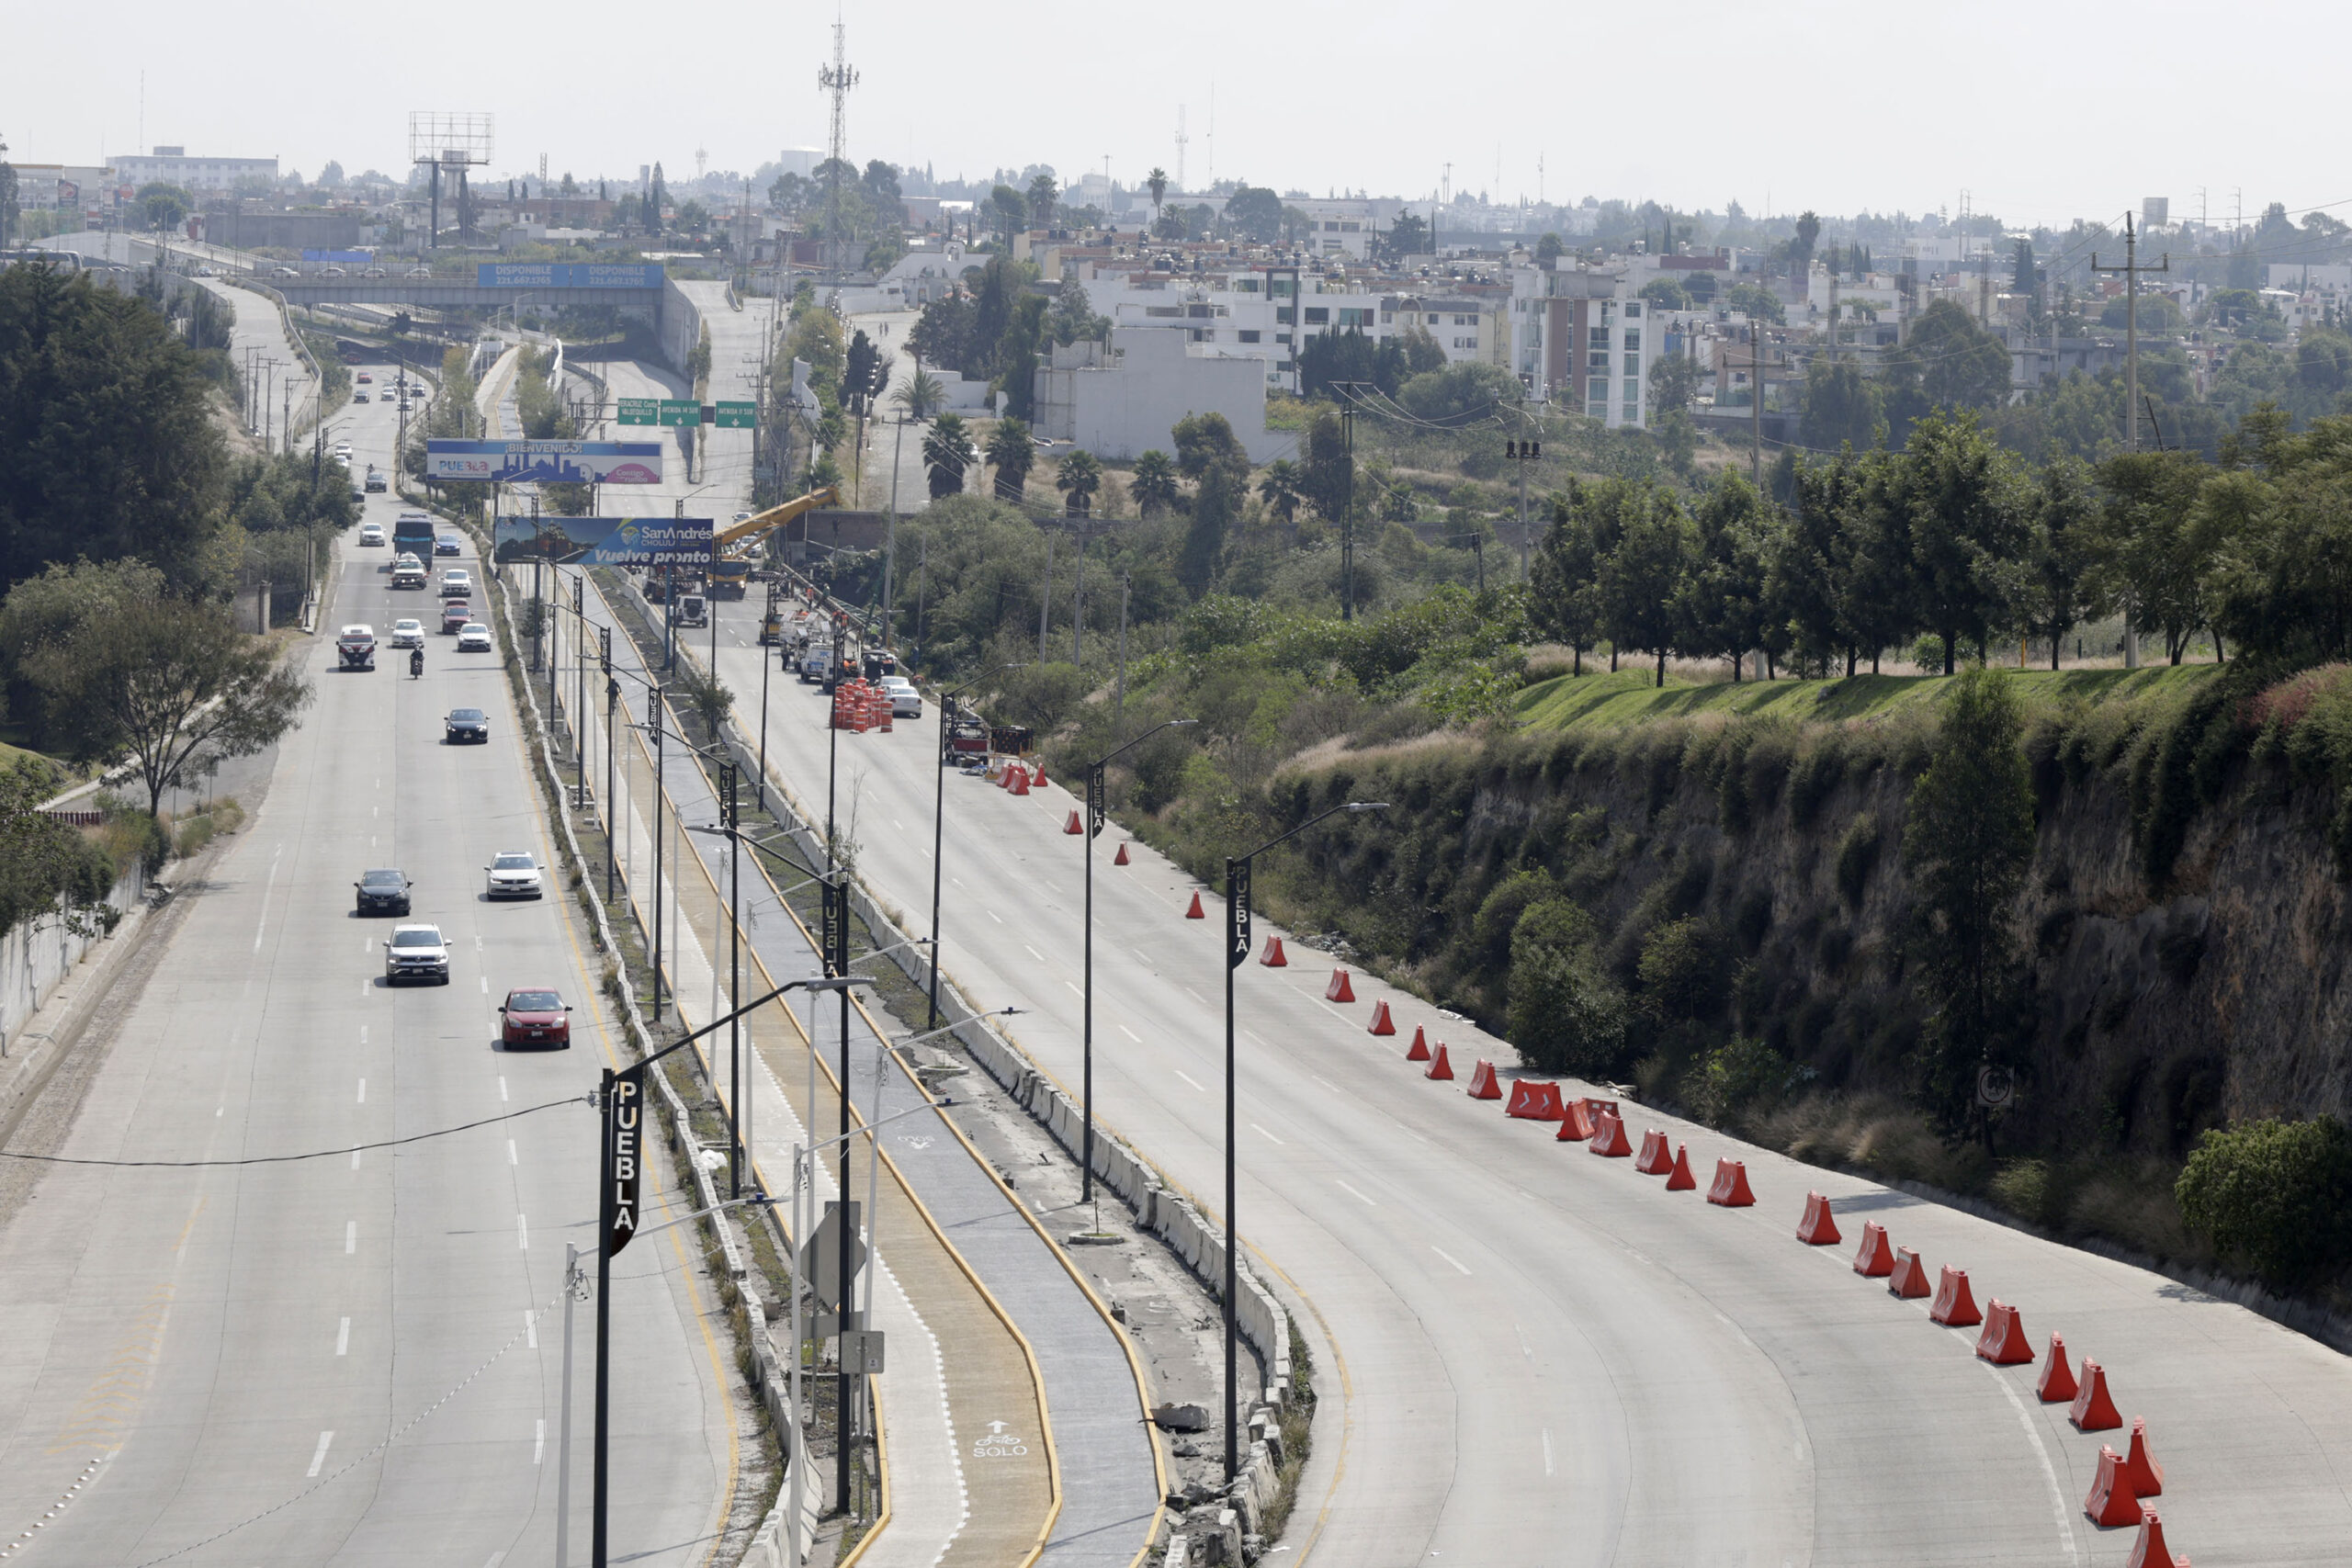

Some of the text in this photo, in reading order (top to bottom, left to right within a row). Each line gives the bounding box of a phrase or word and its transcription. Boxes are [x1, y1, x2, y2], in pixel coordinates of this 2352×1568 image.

[495, 265, 551, 275] DISPONIBLE
[589, 266, 645, 276] DISPONIBLE
[662, 406, 682, 414] AVENIDA
[688, 407, 699, 415] SUR
[743, 408, 753, 416] SUR
[616, 468, 645, 479] Contigo
[594, 549, 711, 564] Vuelve pronto
[1093, 768, 1103, 828] PUEBLA
[1235, 866, 1249, 953] PUEBLA
[614, 1081, 638, 1231] PUEBLA
[974, 1446, 1027, 1458] SOLO
